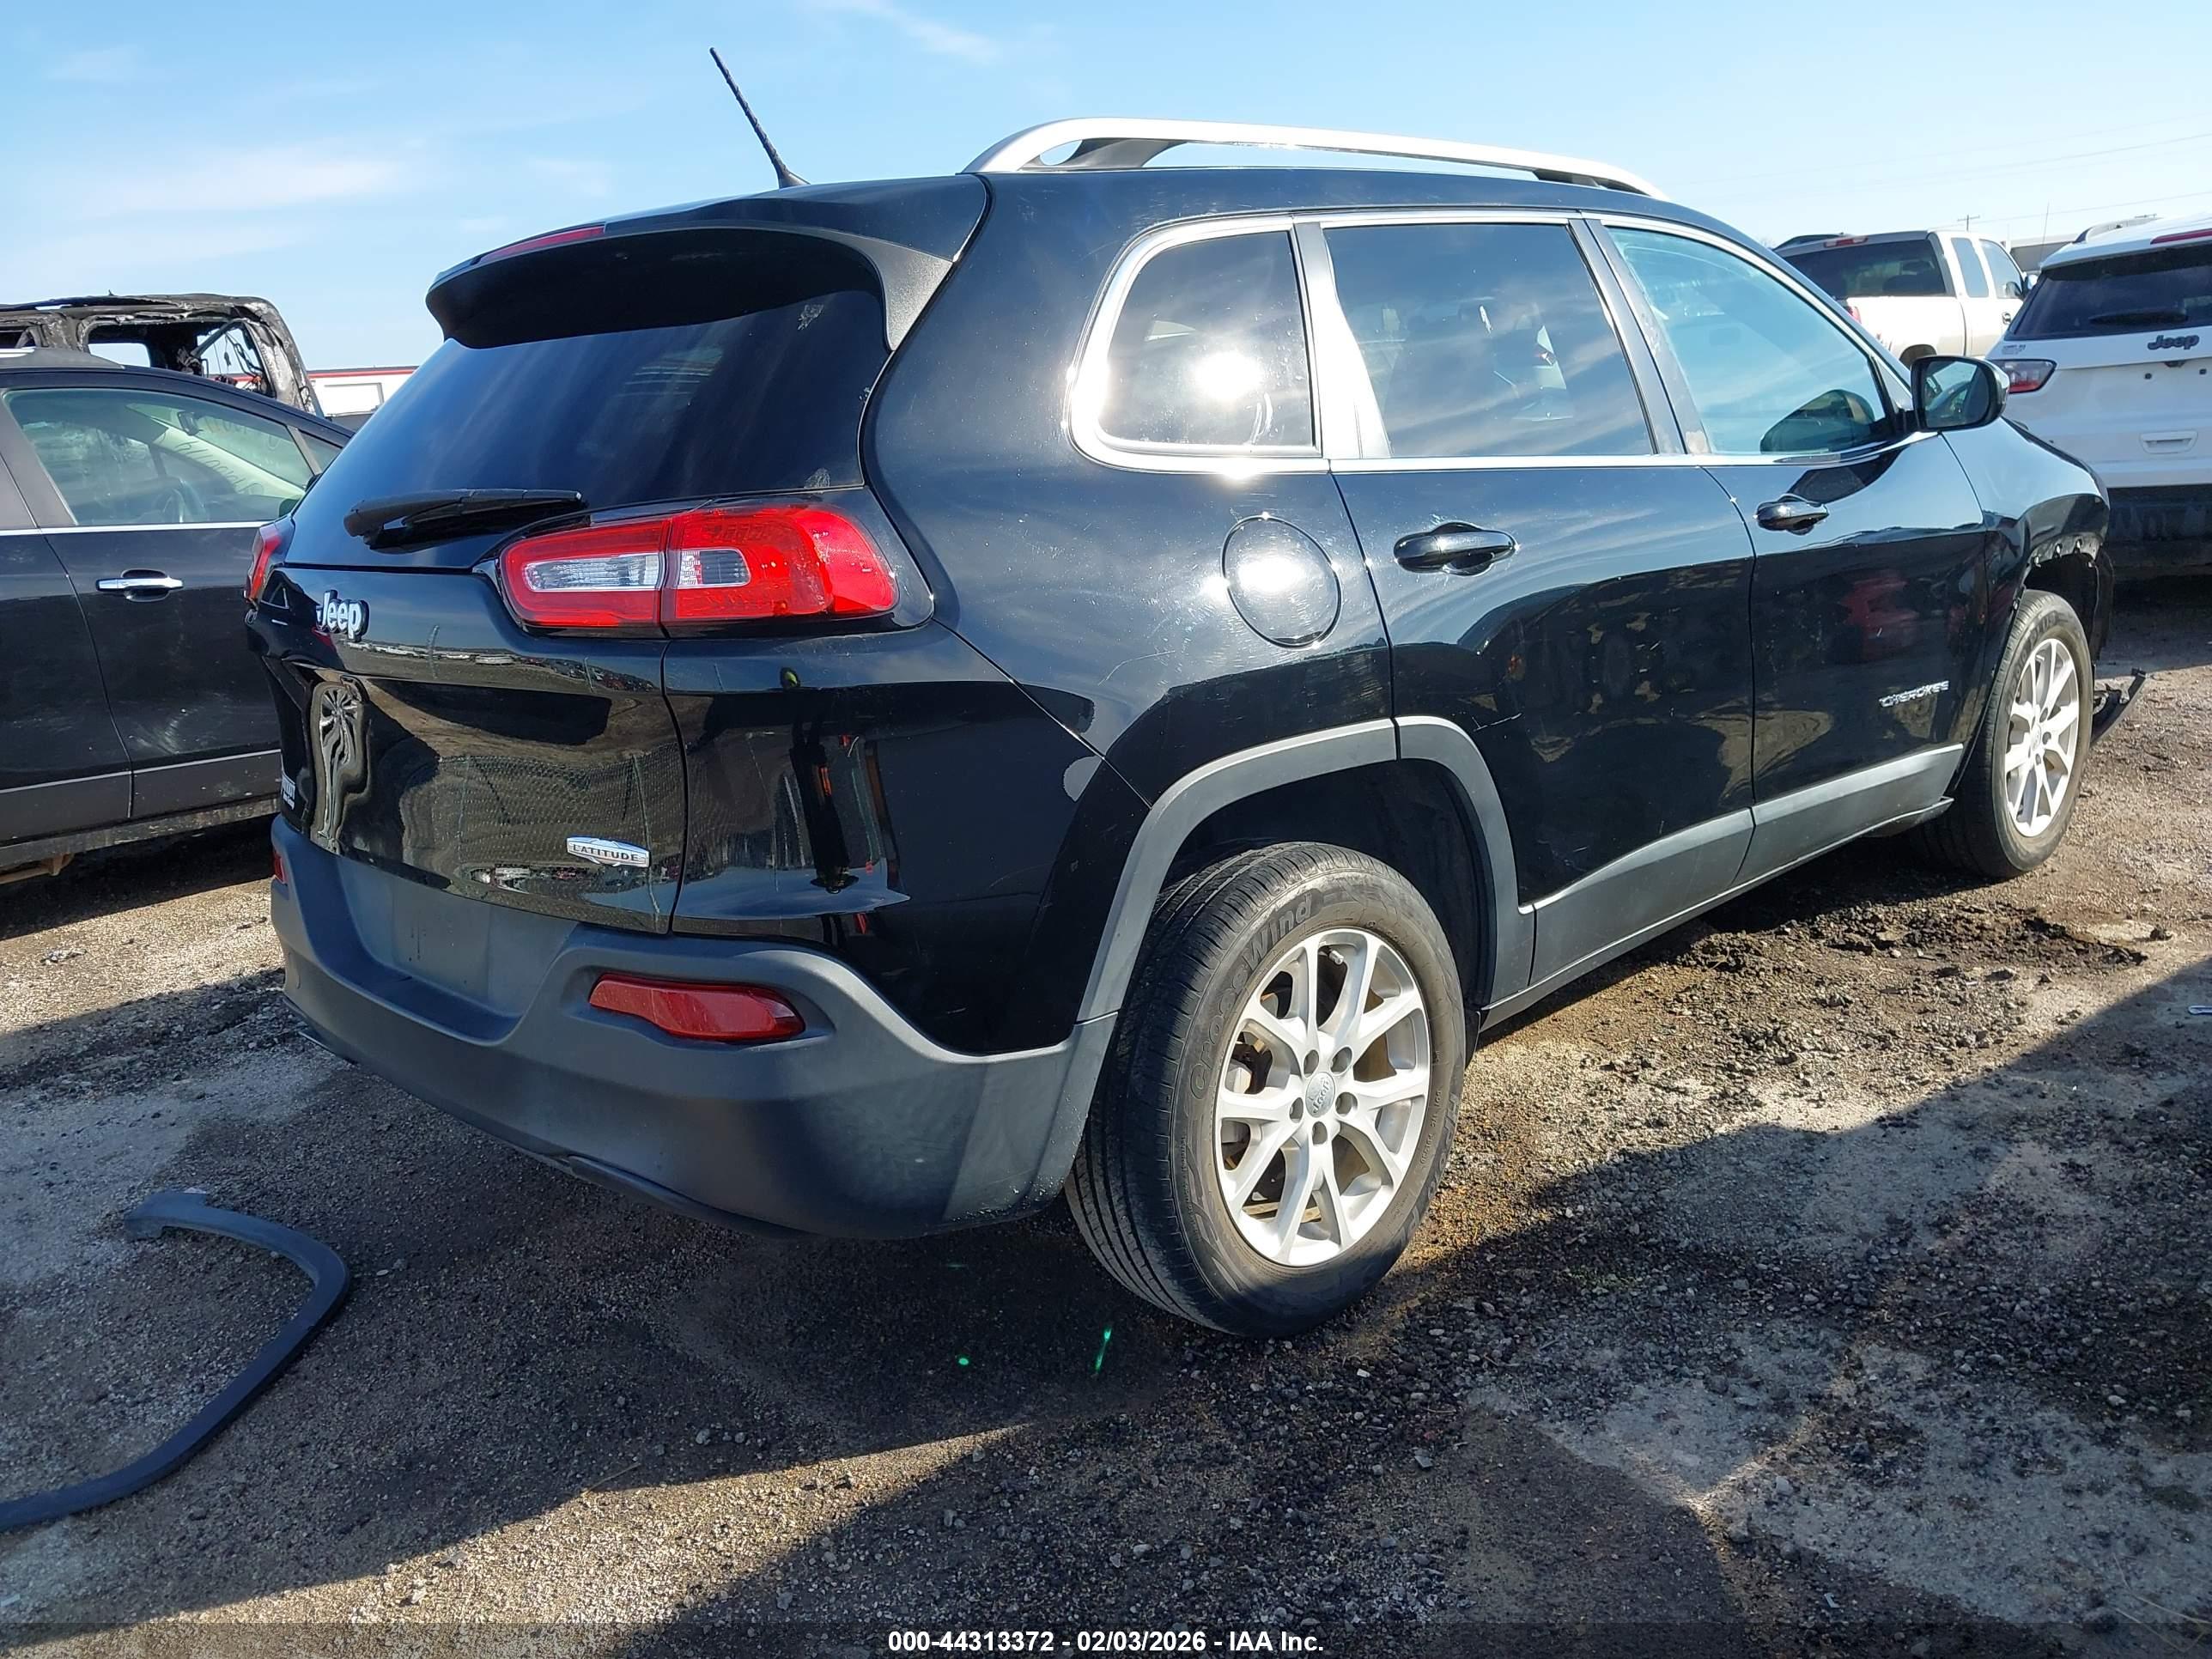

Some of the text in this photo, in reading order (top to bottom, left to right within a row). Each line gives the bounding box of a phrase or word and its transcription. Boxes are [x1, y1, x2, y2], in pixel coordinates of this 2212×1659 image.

[2148, 335, 2200, 350] Jeep
[316, 590, 369, 642] Jeep
[1878, 680, 1949, 708] CHEROKEE
[573, 844, 639, 861] LATITUDE
